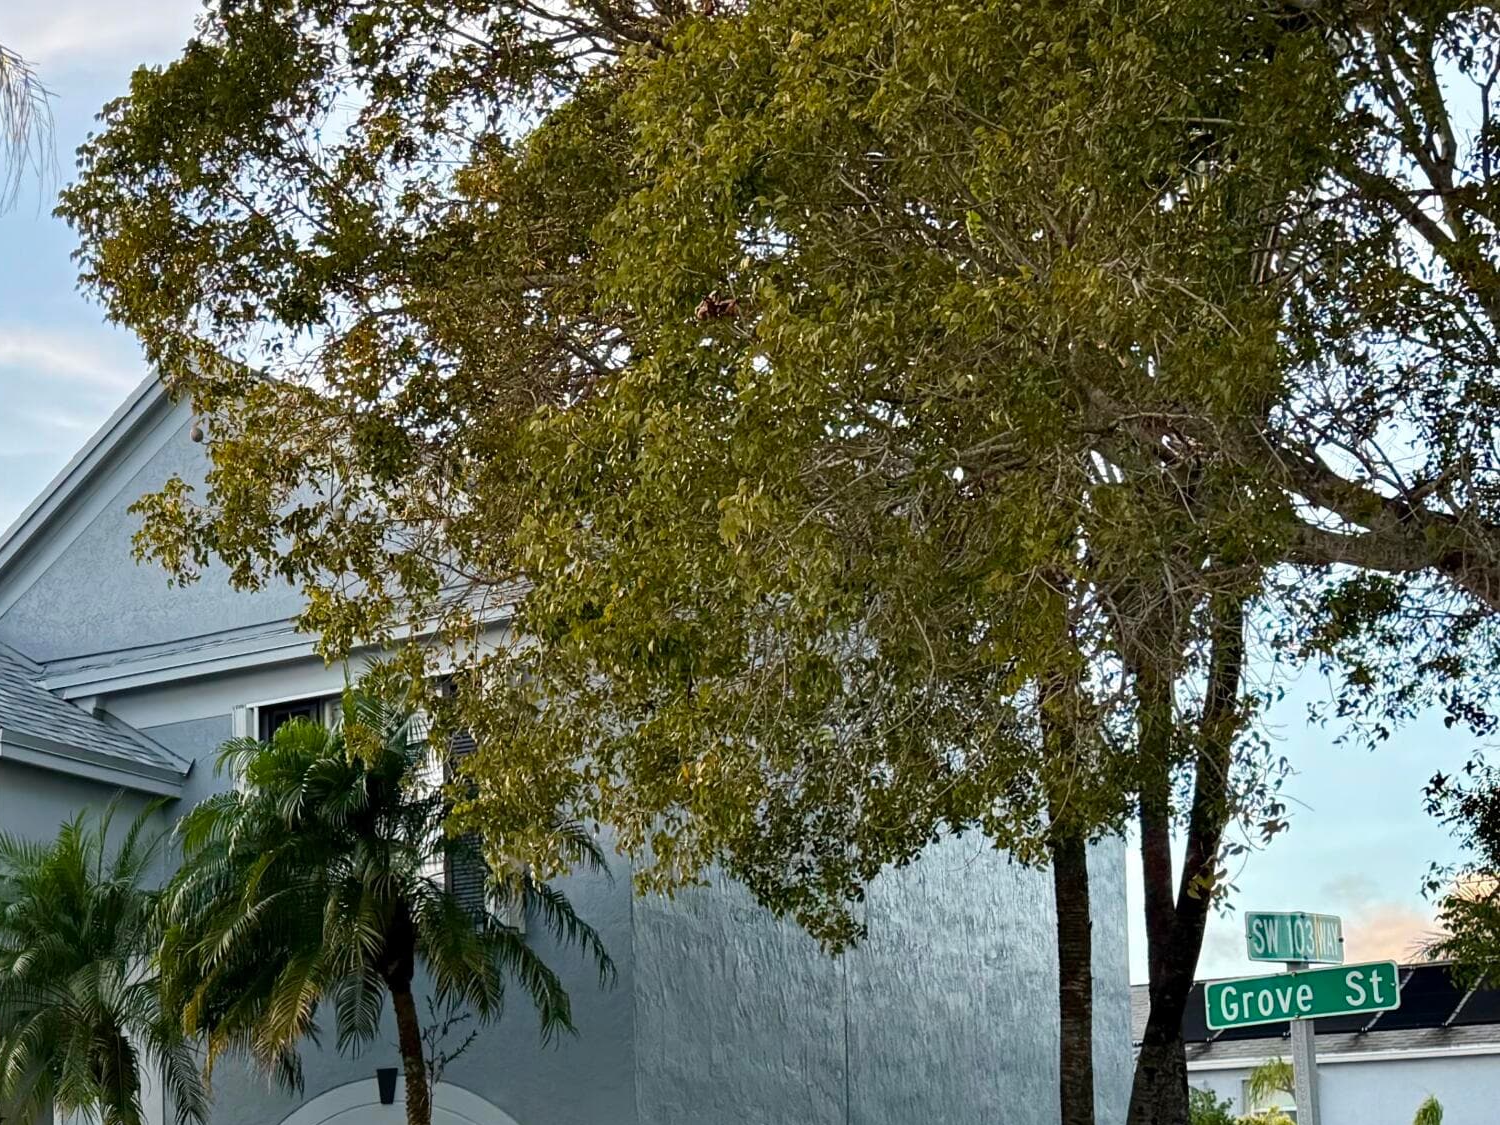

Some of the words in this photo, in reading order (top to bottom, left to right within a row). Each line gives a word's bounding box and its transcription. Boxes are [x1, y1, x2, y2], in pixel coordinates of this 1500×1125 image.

[1252, 918, 1279, 954] SW
[1286, 918, 1315, 955] 103
[1318, 921, 1338, 956] WAY
[1220, 984, 1314, 1022] Grove
[1345, 969, 1384, 1007] St
